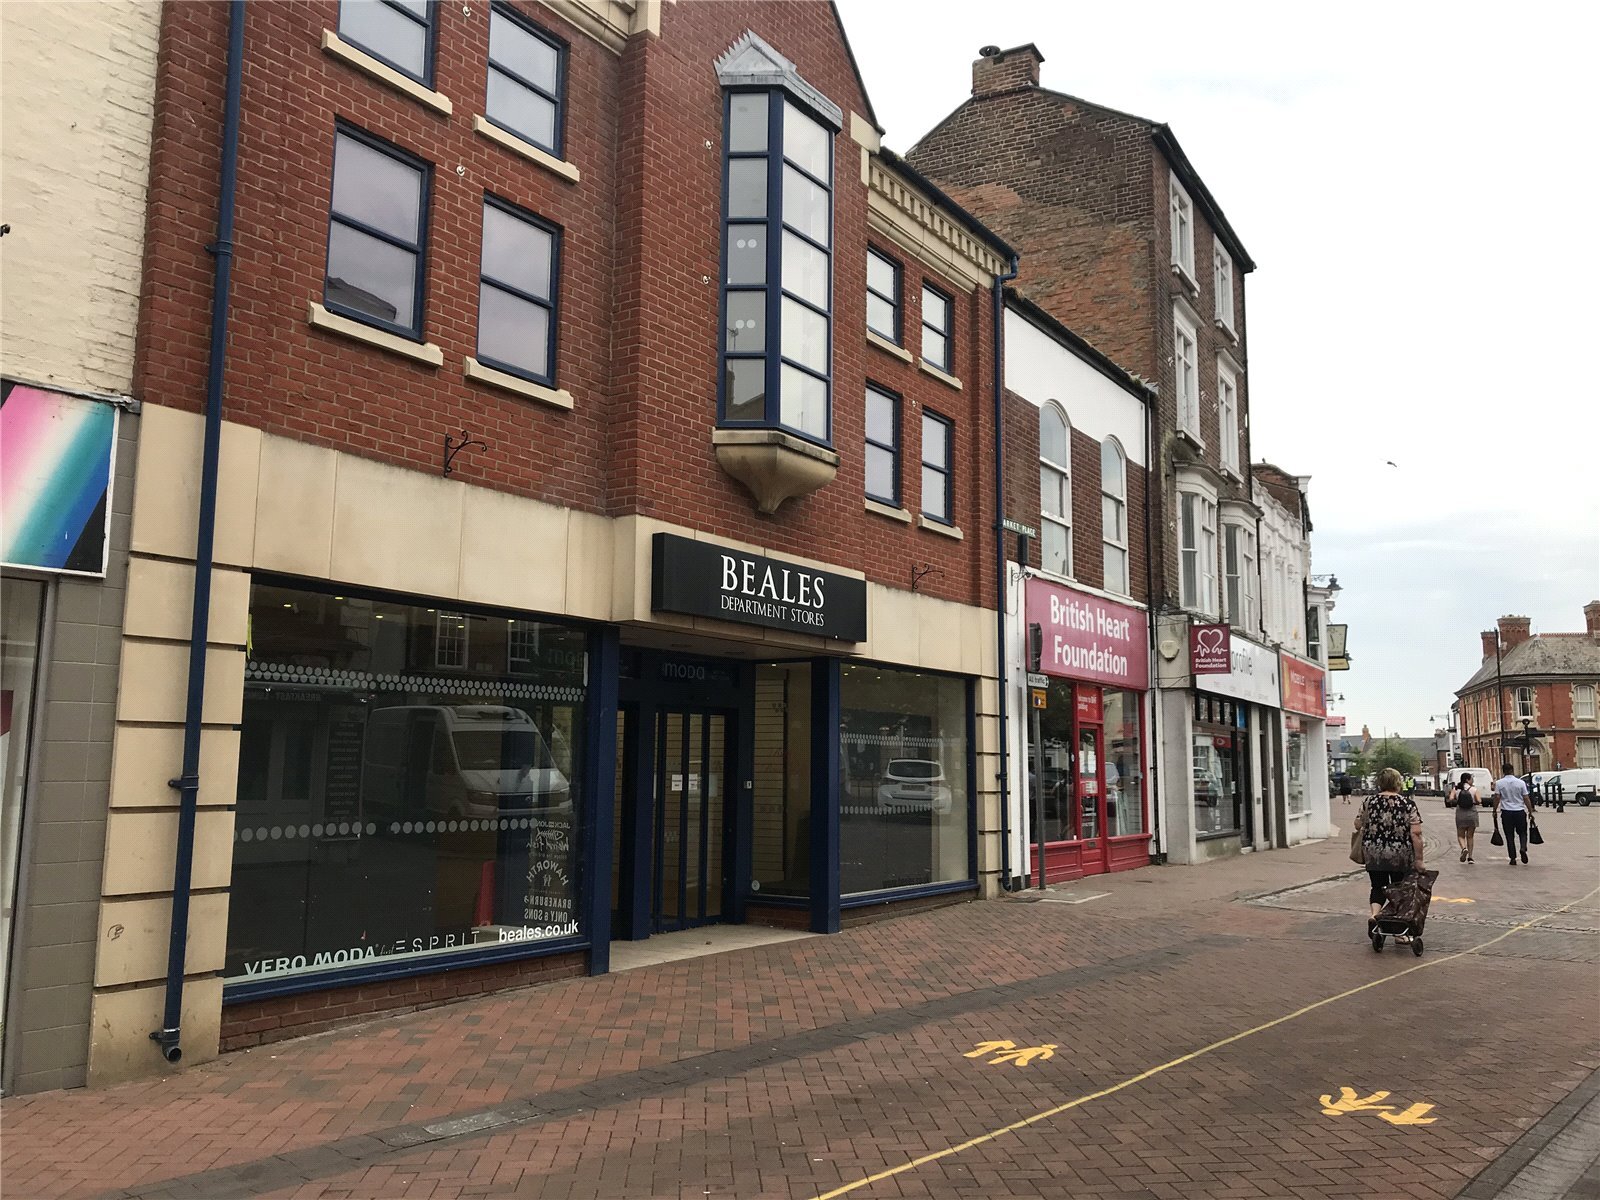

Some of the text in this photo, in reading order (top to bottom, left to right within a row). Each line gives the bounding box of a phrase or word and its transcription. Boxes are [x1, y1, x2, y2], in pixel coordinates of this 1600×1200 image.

[1003, 519, 1036, 537] ARKET PLACE
[721, 555, 824, 608] BEALES
[721, 595, 824, 626] DEPARTMENT STORES
[1050, 594, 1130, 642] British Heart
[1054, 635, 1128, 677] Foundation
[244, 955, 306, 975] VERO
[313, 946, 376, 967] MODA
[395, 930, 480, 954] ESPRIT
[499, 919, 579, 943] beales.co.uk
